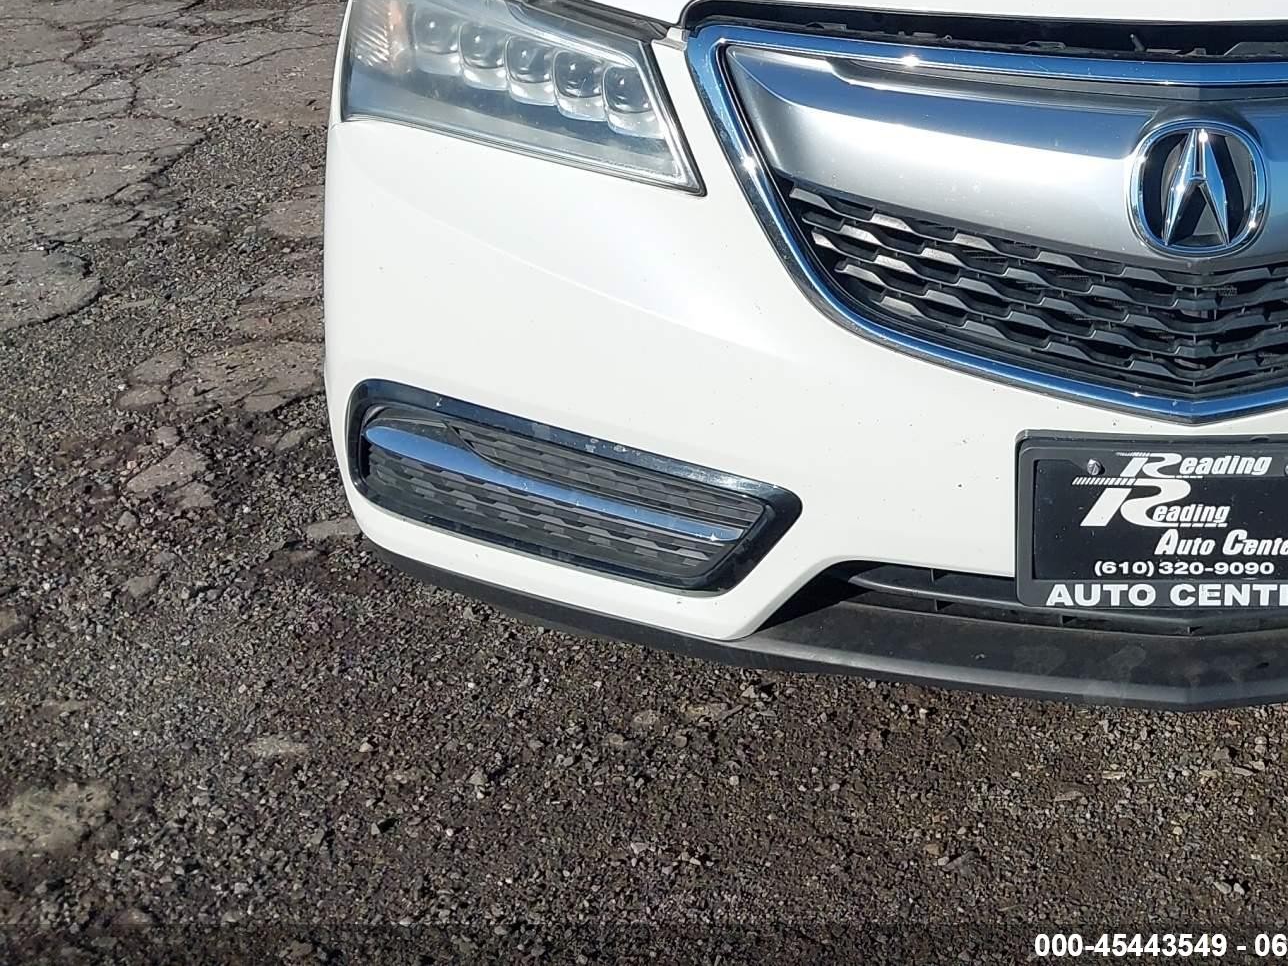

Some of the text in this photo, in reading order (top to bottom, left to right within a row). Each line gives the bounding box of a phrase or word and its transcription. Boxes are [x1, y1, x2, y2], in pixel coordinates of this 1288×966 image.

[1116, 452, 1273, 479] Reading
[1073, 477, 1231, 528] Reading
[1154, 528, 1216, 556] Auto
[1094, 561, 1275, 577] (610) 320-9090
[1045, 583, 1157, 607] AUTO
